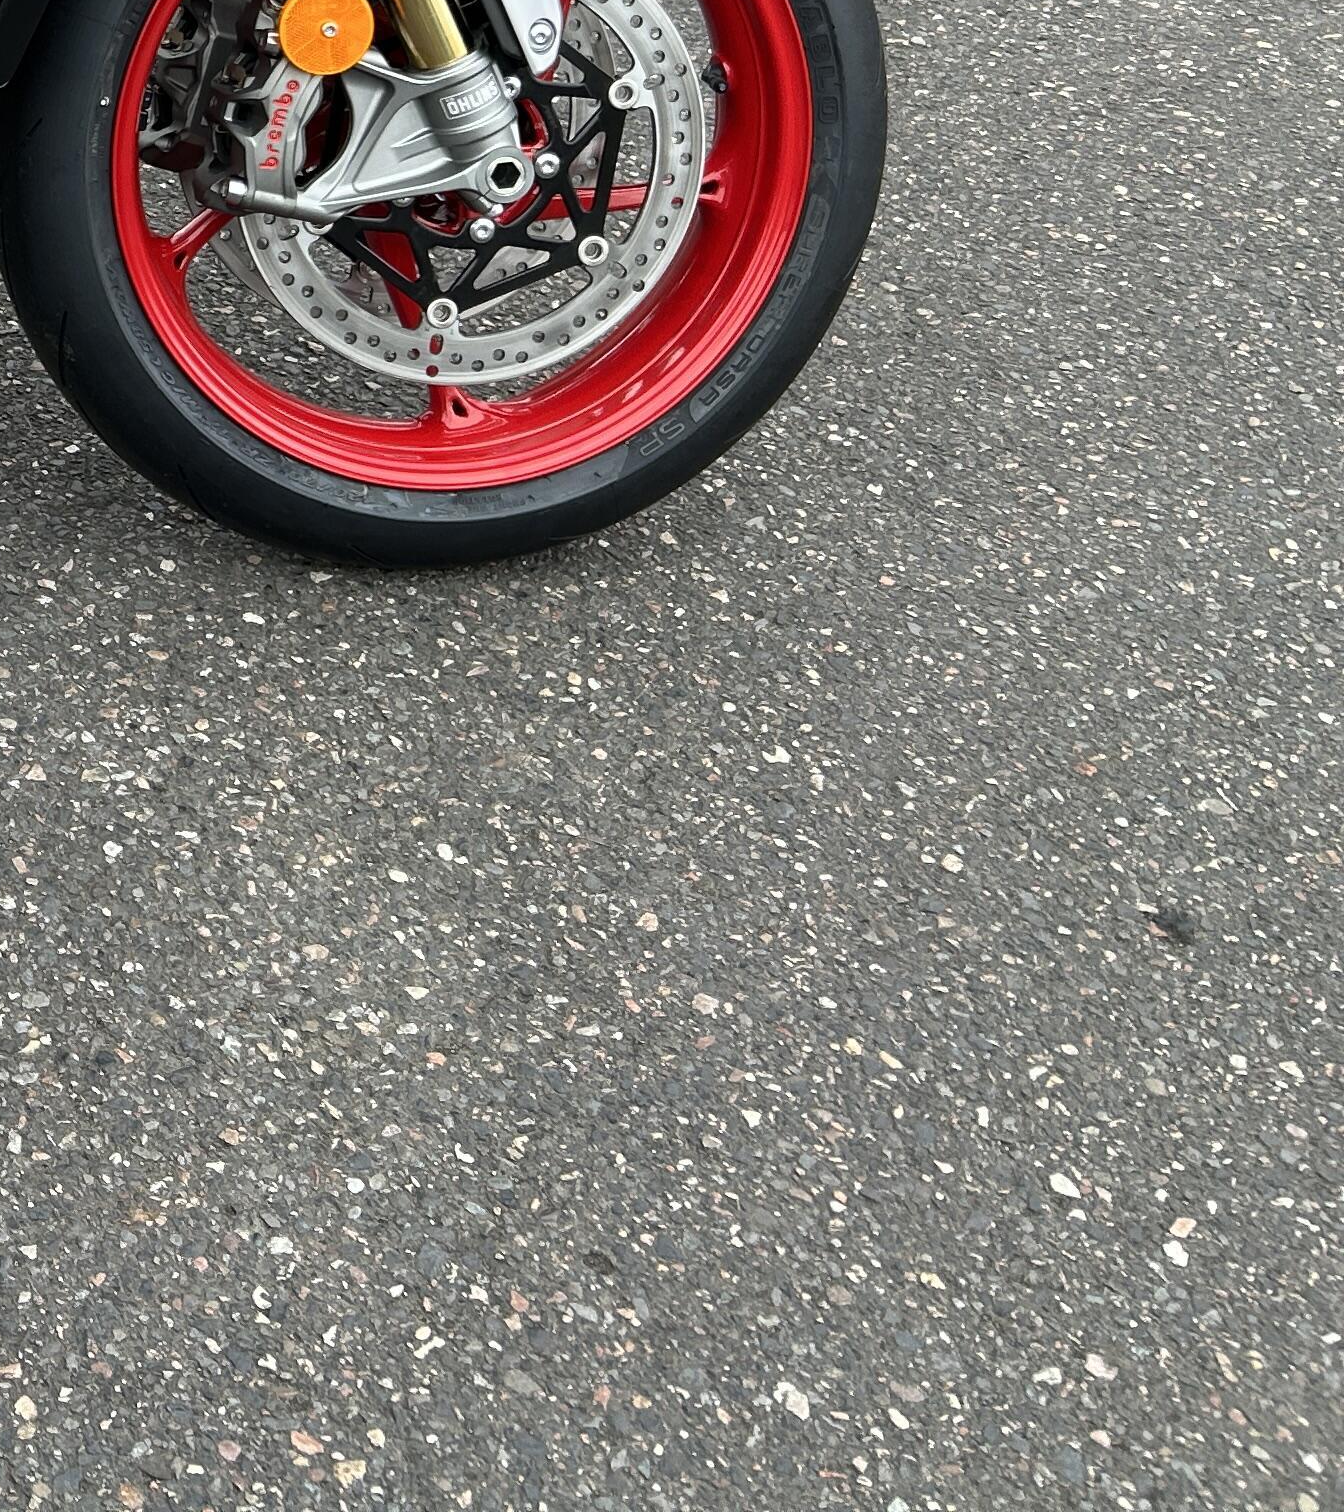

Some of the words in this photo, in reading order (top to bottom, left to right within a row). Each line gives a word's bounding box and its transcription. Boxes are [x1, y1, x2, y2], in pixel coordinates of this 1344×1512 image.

[445, 80, 499, 115] ÖHLINS
[258, 79, 300, 170] brembo
[638, 420, 685, 457] SP
